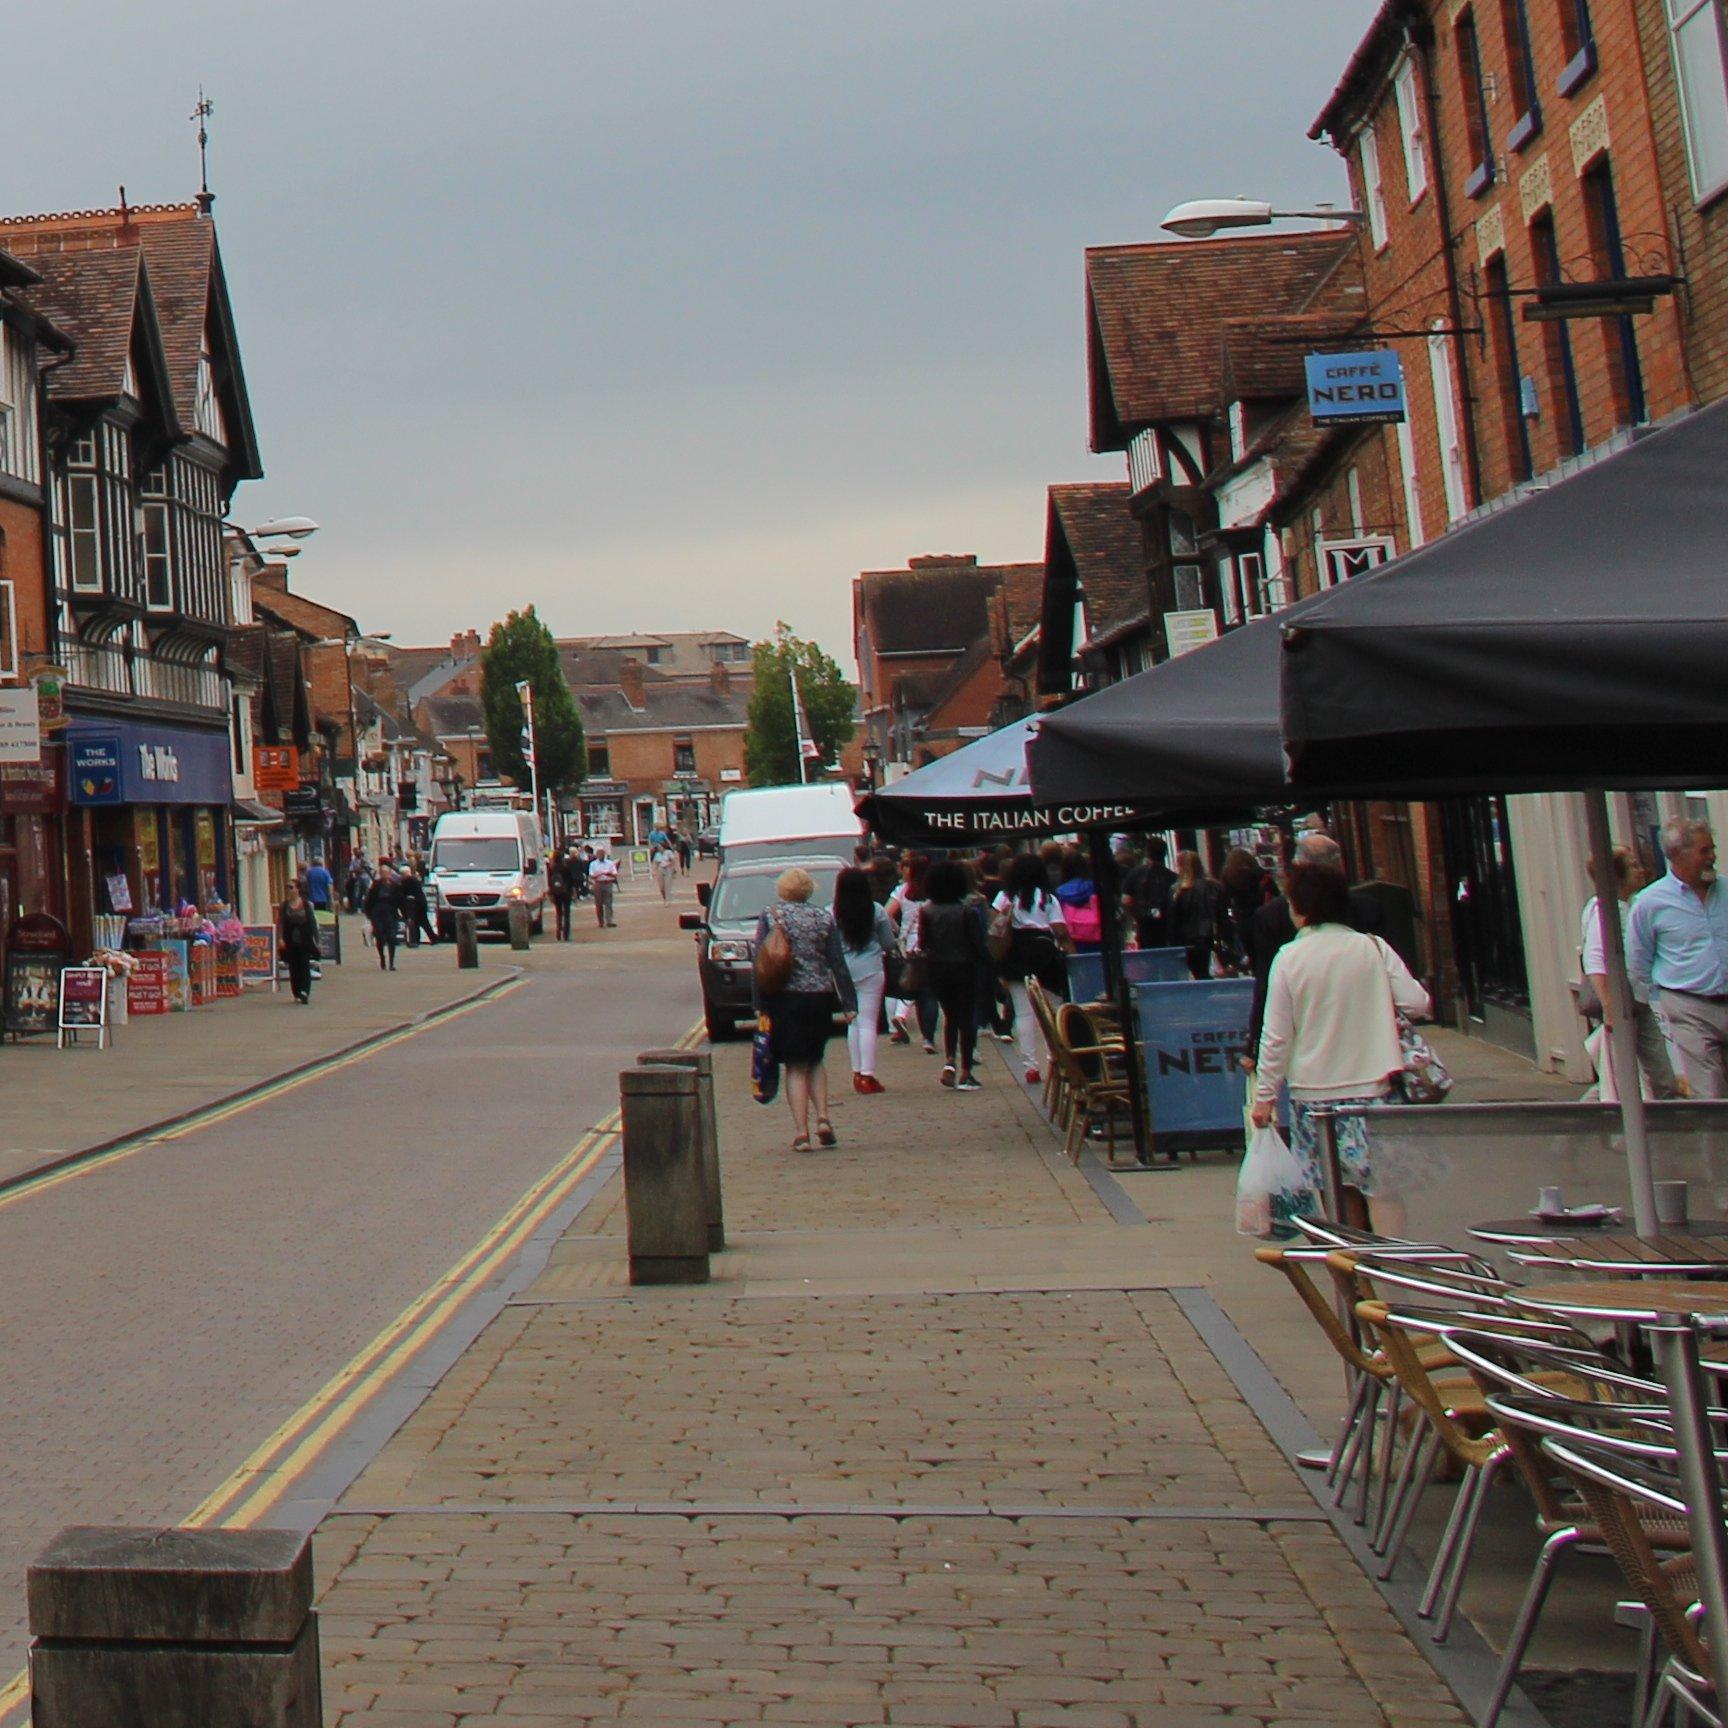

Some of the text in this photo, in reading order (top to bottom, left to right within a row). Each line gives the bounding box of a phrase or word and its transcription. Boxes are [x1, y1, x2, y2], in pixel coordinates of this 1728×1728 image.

[1314, 382, 1397, 402] NERO
[85, 747, 106, 757] THE
[76, 758, 116, 767] WORKS
[138, 743, 178, 782] The Works
[924, 811, 965, 829] THE
[973, 809, 1050, 830] ITALIAN
